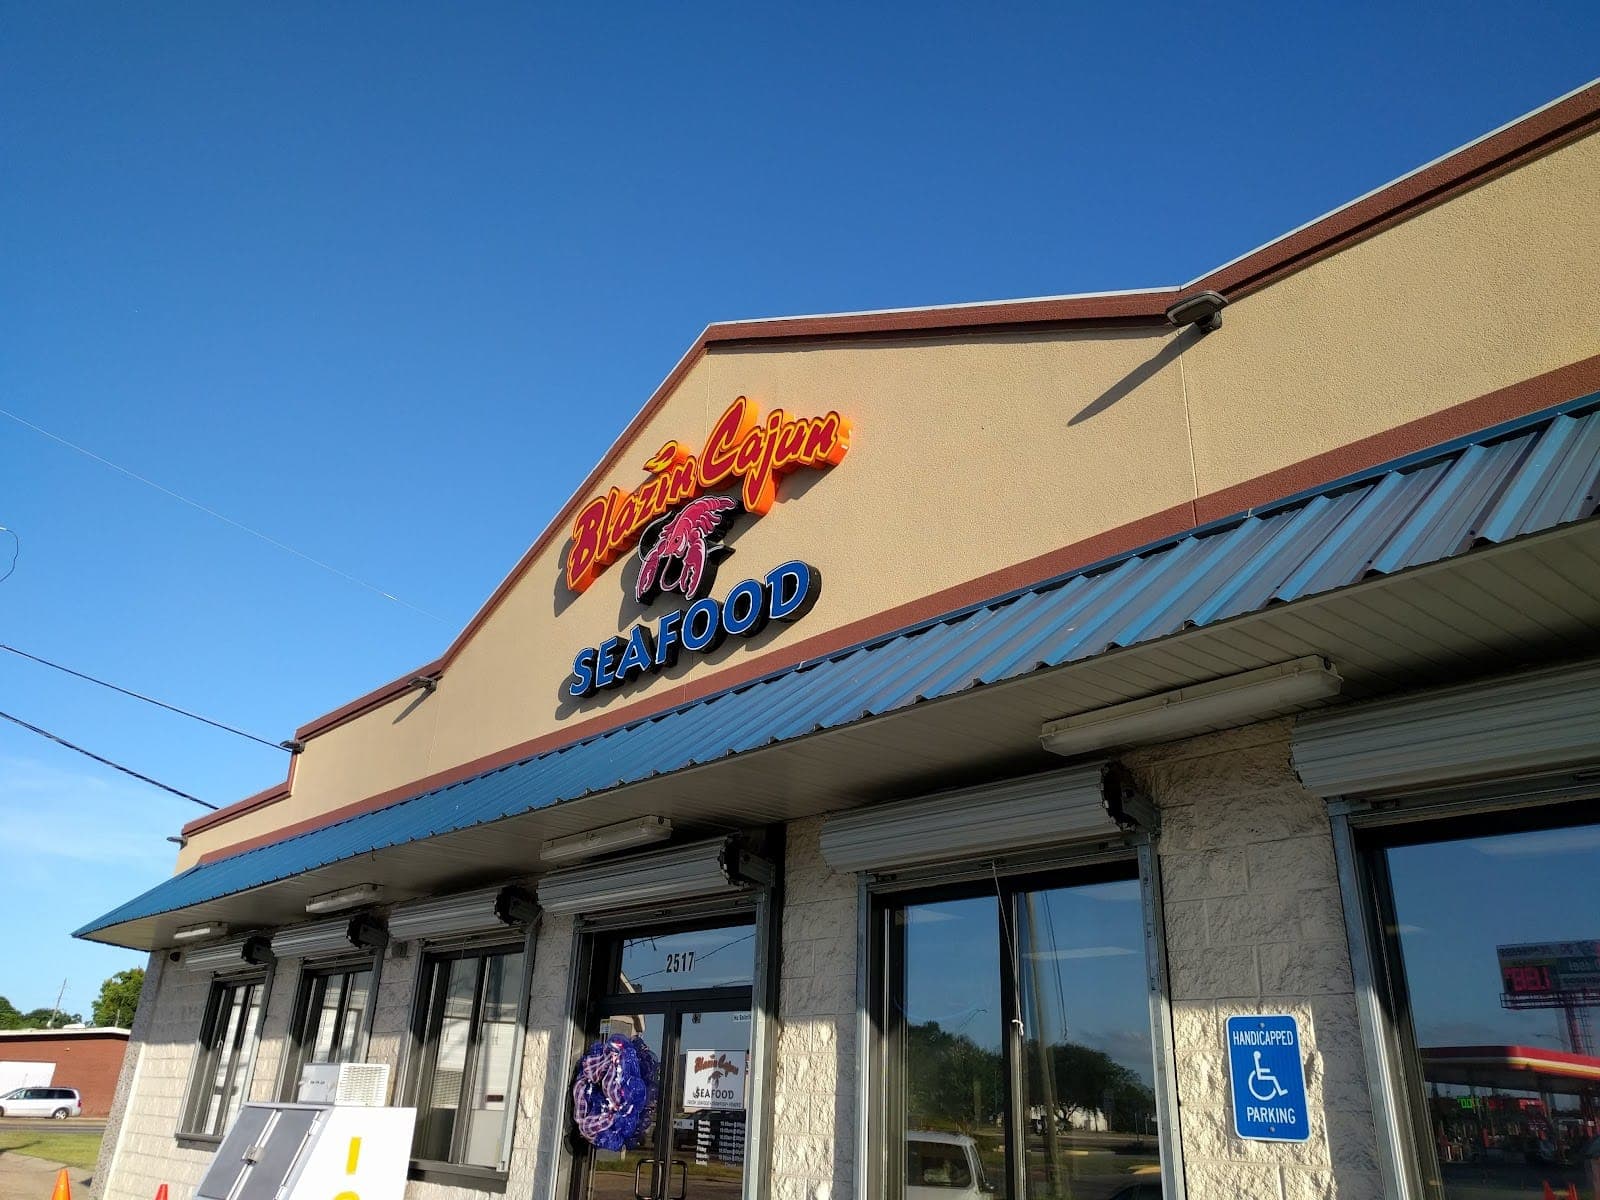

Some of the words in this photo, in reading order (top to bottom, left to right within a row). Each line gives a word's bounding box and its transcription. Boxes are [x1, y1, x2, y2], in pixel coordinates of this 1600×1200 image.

[698, 396, 843, 514] Cajun
[569, 559, 814, 697] SEAFOOD
[666, 951, 695, 973] 2517
[1232, 1030, 1294, 1046] HANDICAPPED
[693, 1088, 734, 1099] SEAFOOD
[1246, 1106, 1296, 1124] PARKING
